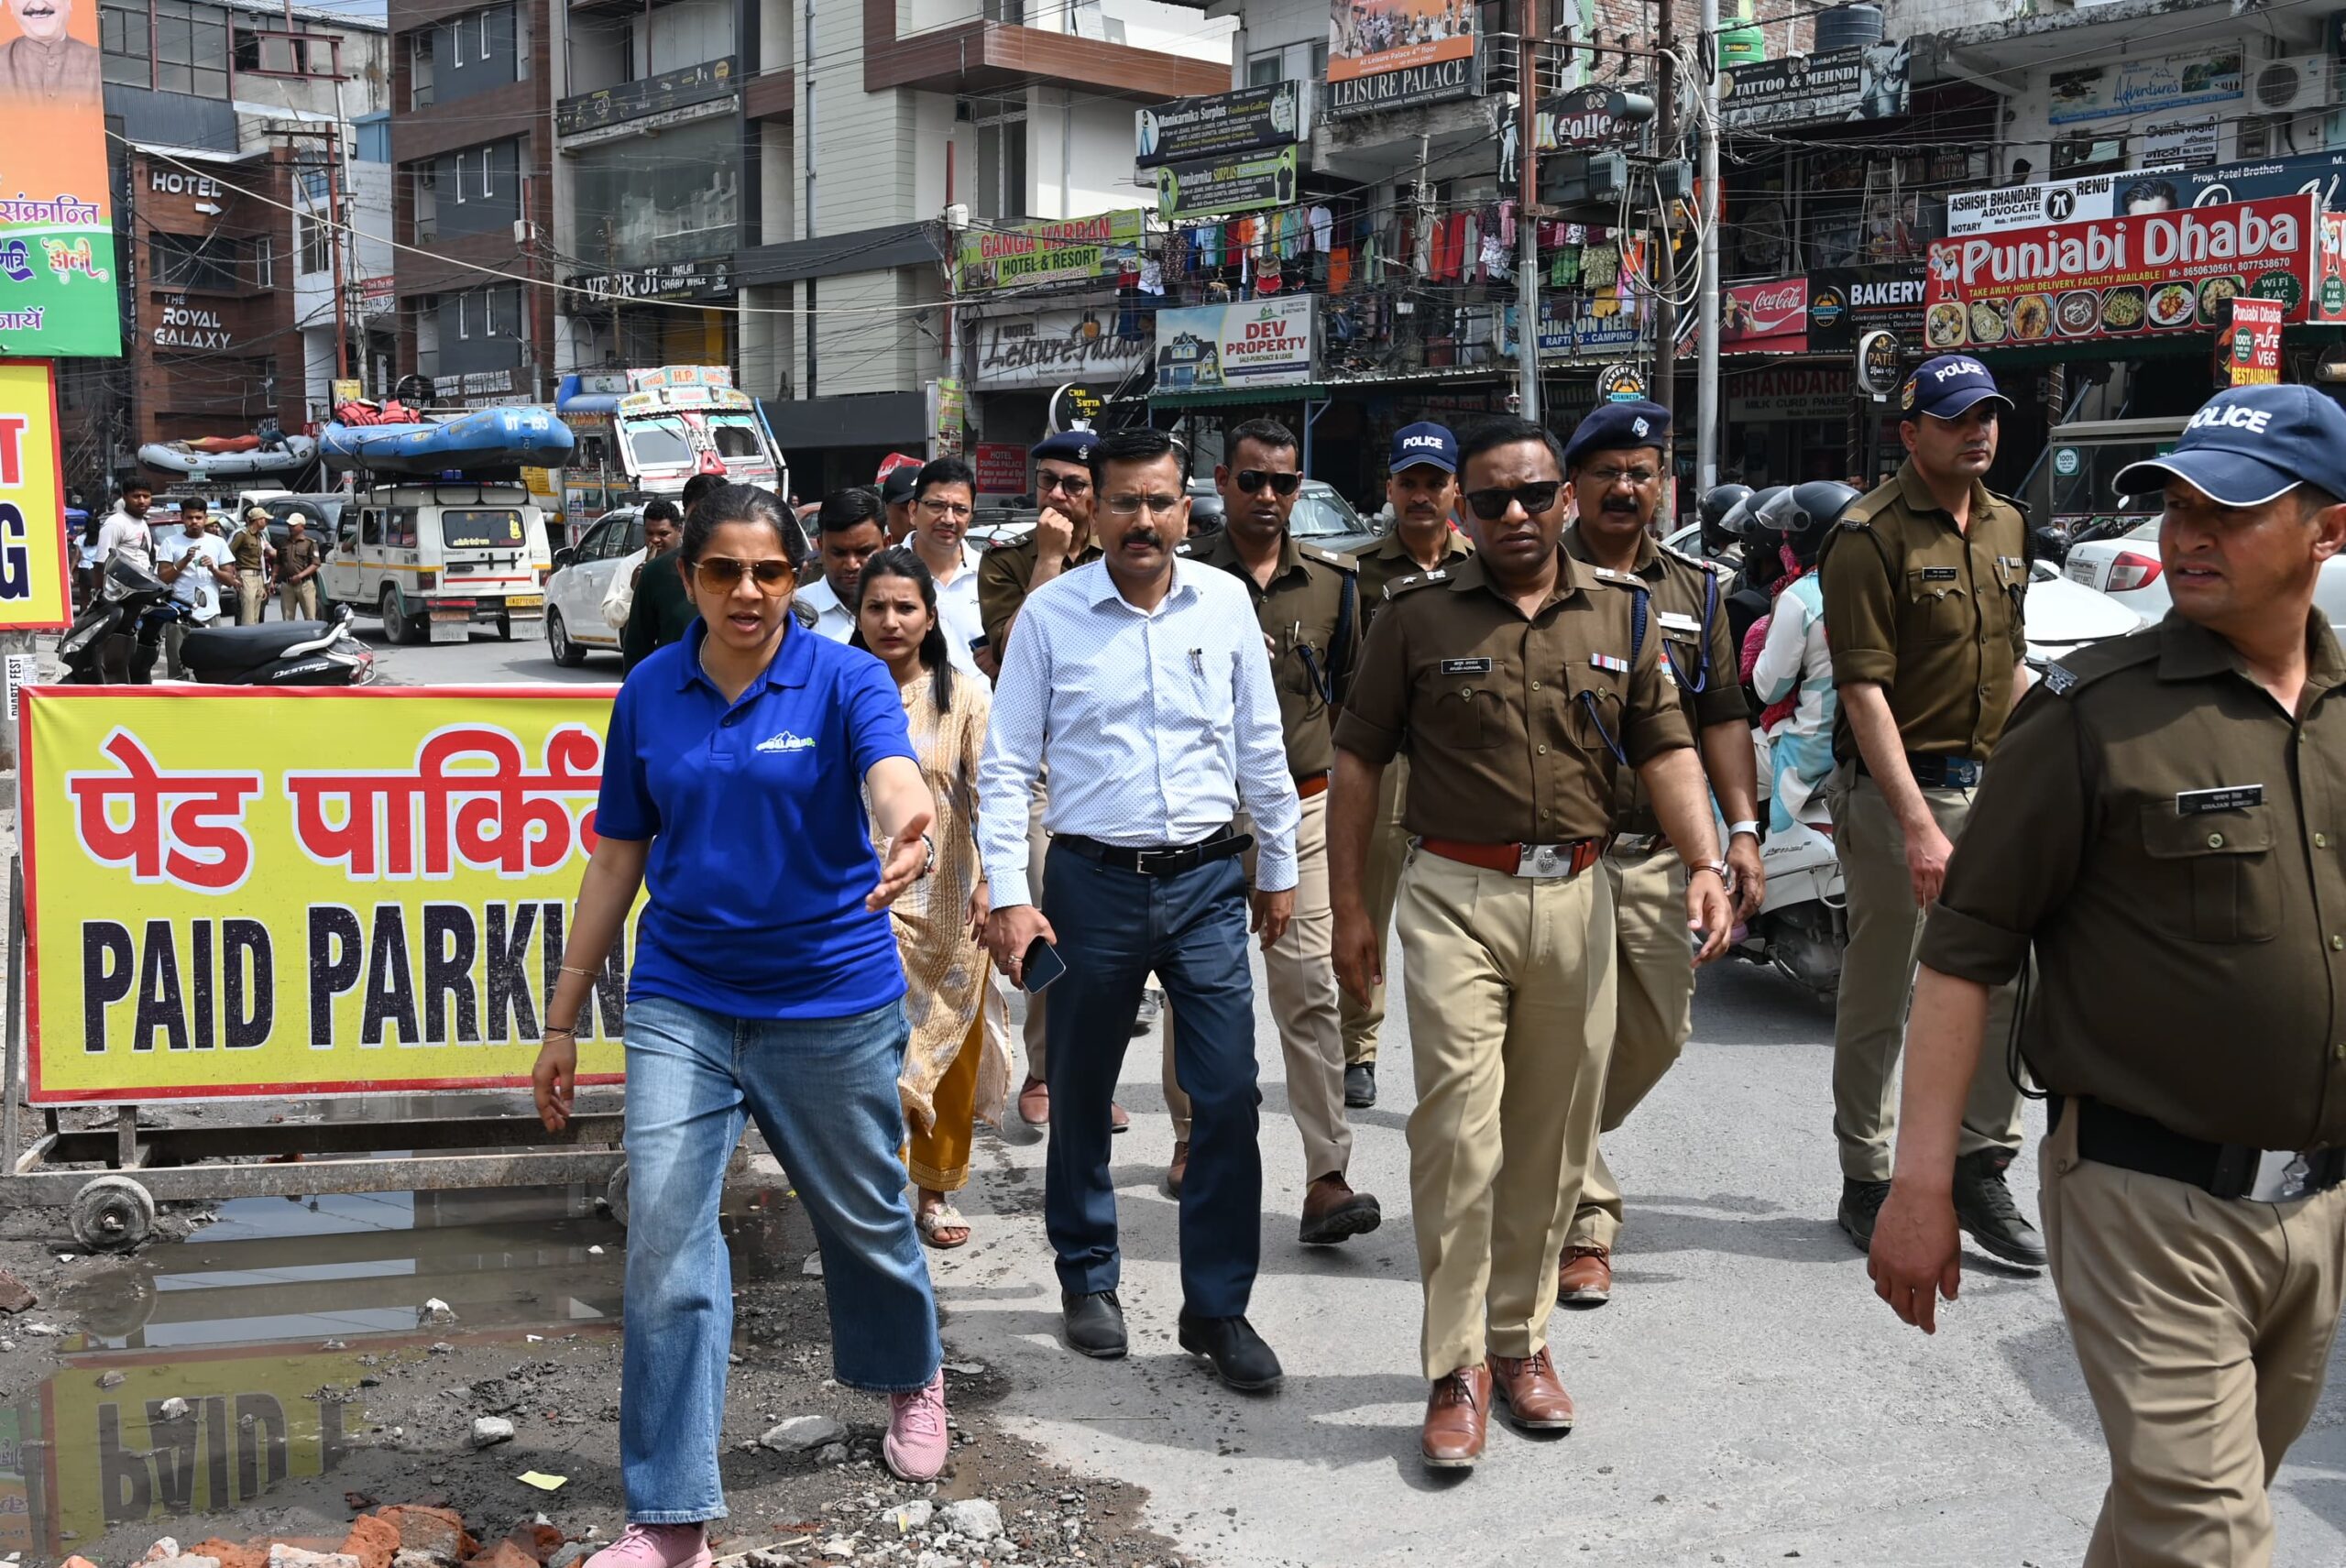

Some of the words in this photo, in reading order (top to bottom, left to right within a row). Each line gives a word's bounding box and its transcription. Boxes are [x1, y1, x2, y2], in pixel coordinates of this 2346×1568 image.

[1334, 71, 1398, 106] LEISURE
[1403, 59, 1465, 94] PALACE
[1735, 77, 1785, 96] TATTOO
[1790, 74, 1801, 88] &
[1805, 65, 1858, 85] MEHNDI
[2114, 74, 2179, 106] Adventures
[1754, 91, 1781, 104] Permanent
[1158, 110, 1199, 127] Manikarnika
[1200, 104, 1226, 121] Surplus
[2192, 172, 2216, 183] Prop.
[2219, 169, 2242, 181] Patel
[2243, 164, 2284, 178] Brothers
[152, 171, 223, 198] HOTEL
[1952, 194, 1987, 212] ASHISH
[1990, 187, 2042, 208] BHANDARI
[2077, 178, 2110, 196] RENU
[1981, 202, 2041, 218] ADVOCATE
[1951, 222, 1981, 233] NOTARY
[981, 229, 1036, 259] GANGA
[1963, 222, 2127, 284] Punjabi
[2143, 206, 2299, 266] Dhaba
[672, 263, 695, 276] MALAI
[1003, 257, 1036, 276] HOTEL
[1040, 255, 1049, 270] &
[1053, 247, 1098, 269] RESORT
[2183, 264, 2236, 277] 8650630561,
[2238, 258, 2290, 270] 8077538670
[641, 268, 659, 295] JI
[1969, 289, 1988, 298] TAKE
[1990, 286, 2012, 296] AWAY,
[2013, 283, 2035, 294] HOME
[2037, 280, 2077, 291] DELIVERY,
[2078, 276, 2113, 288] FACILITY
[2116, 270, 2161, 284] AVAILABLE
[2262, 278, 2276, 288] Wi
[2278, 276, 2288, 286] Fi
[164, 294, 186, 304] THE
[1850, 280, 1926, 306] BAKERY
[2273, 289, 2288, 299] AC
[163, 308, 222, 328] ROYAL
[2232, 304, 2259, 321] Punjabi
[2259, 306, 2282, 323] Dhaba
[1003, 323, 1036, 339] HOTEL
[1245, 321, 1287, 340] DEV
[1576, 317, 1598, 334] ON
[1605, 314, 1633, 331] REN
[154, 328, 231, 349] GALAXY
[1226, 336, 1307, 356] PROPERTY
[1546, 333, 1584, 346] RAFTIG
[1592, 331, 1633, 343] CAMPING
[2235, 334, 2252, 345] 100%
[1868, 352, 1900, 367] PATEL
[2257, 350, 2276, 366] VEG
[674, 370, 695, 382] H.P.
[1606, 367, 1629, 390] BAKERY
[1935, 361, 1984, 382] POLICE
[2231, 367, 2279, 385] RESTAURANT
[1068, 389, 1086, 397] CHAI
[1745, 399, 1770, 411] MILK
[1776, 398, 1807, 409] CURD
[1813, 396, 1849, 406] PANEE
[2182, 404, 2273, 434] POLICE
[1403, 434, 1443, 450] POLICE
[990, 451, 1013, 459] HOTEL
[9, 659, 21, 679] FEST
[70, 729, 259, 889] पेड
[82, 919, 273, 1052] PAID
